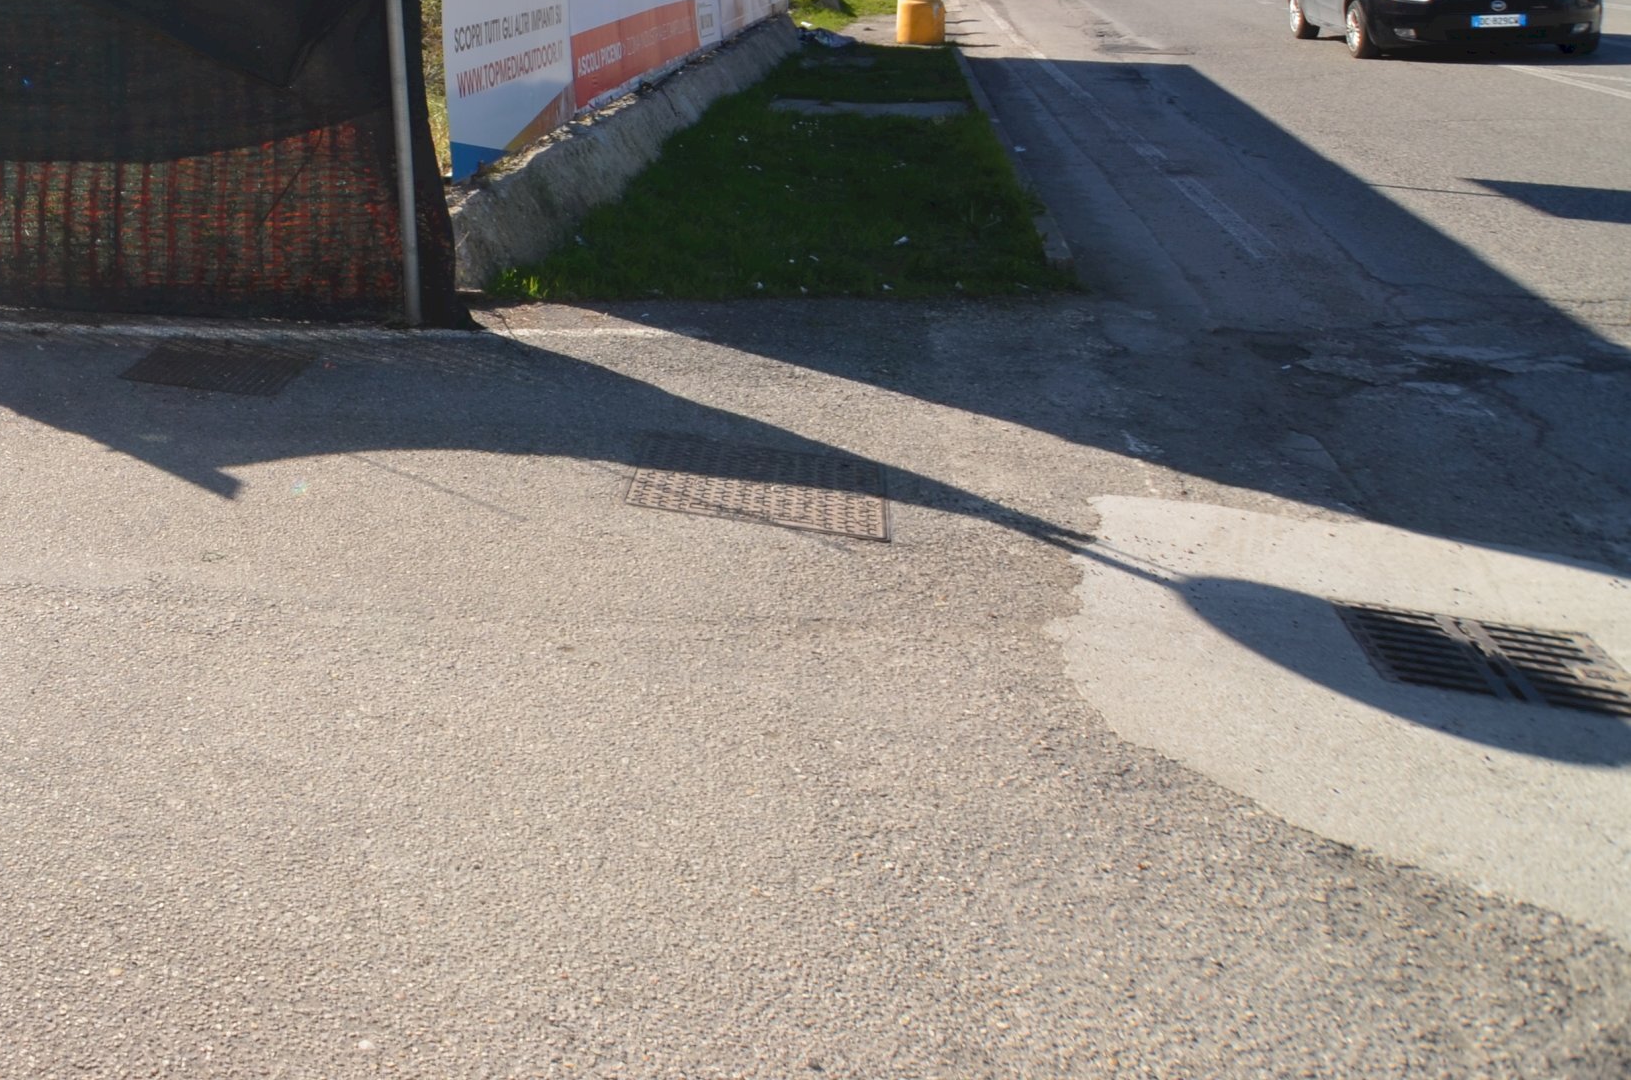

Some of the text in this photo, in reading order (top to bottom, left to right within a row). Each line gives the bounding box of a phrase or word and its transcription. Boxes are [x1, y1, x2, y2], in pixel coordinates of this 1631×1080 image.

[454, 23, 482, 53] SCOPRI
[484, 18, 501, 44] TUTTI
[502, 16, 513, 40] GLI
[514, 11, 529, 37] ALTRI
[531, 5, 554, 32] IMPIANTI
[456, 40, 563, 98] WWW.TOPMEDIAOUTDOOR.IT
[577, 51, 600, 78] ASCOLI
